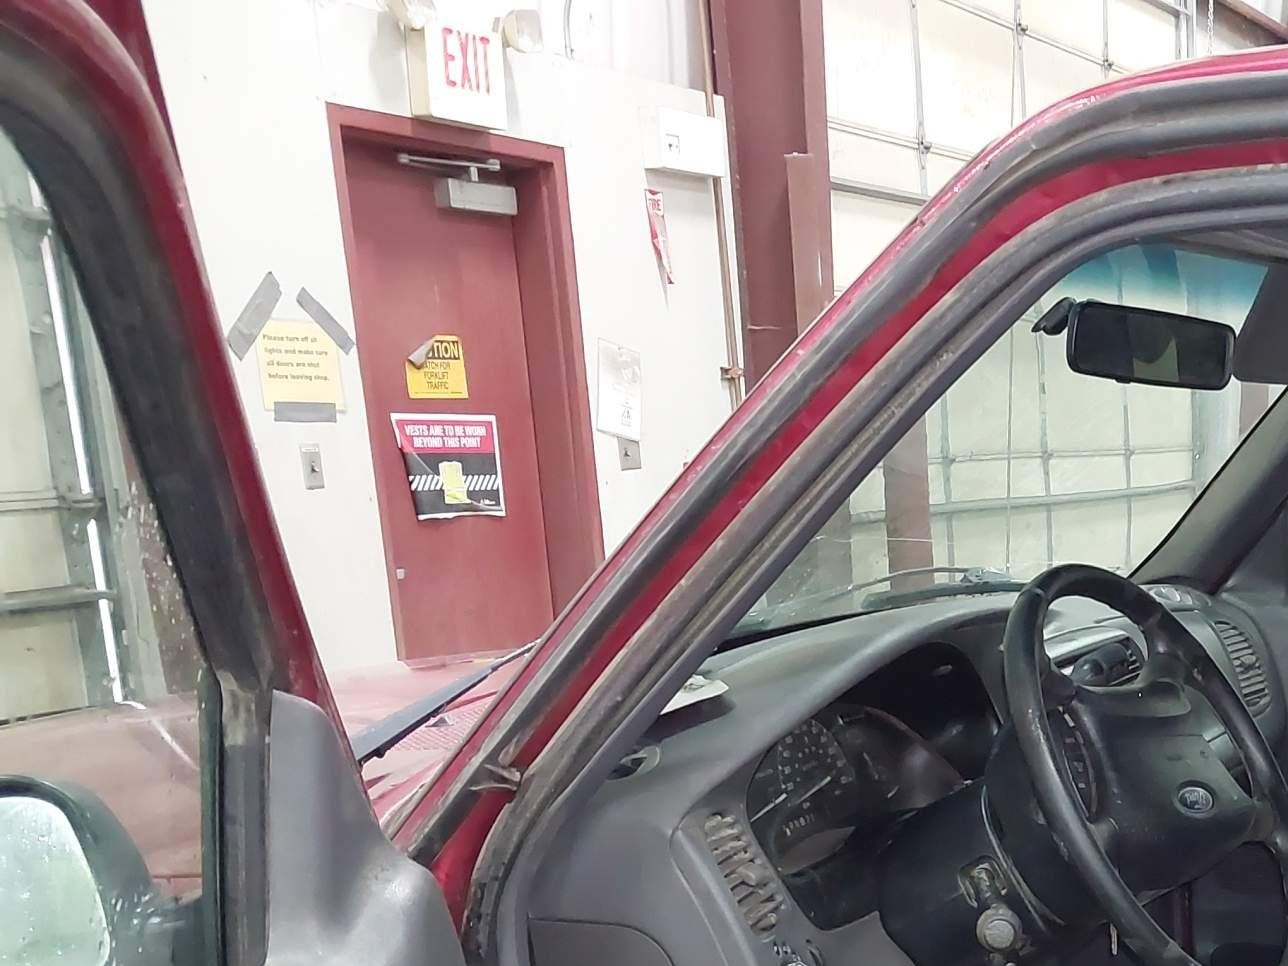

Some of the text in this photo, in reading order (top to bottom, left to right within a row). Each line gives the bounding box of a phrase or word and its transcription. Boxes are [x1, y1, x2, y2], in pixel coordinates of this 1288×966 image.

[442, 27, 490, 95] EXIT
[429, 341, 459, 359] TION
[424, 361, 439, 369] ATCH
[424, 371, 449, 380] FORKLIFT
[426, 381, 449, 390] TRAFFIC
[404, 424, 487, 437] VESTS ARE TO BE WORN
[412, 436, 481, 448] BEYOND THIS POINT
